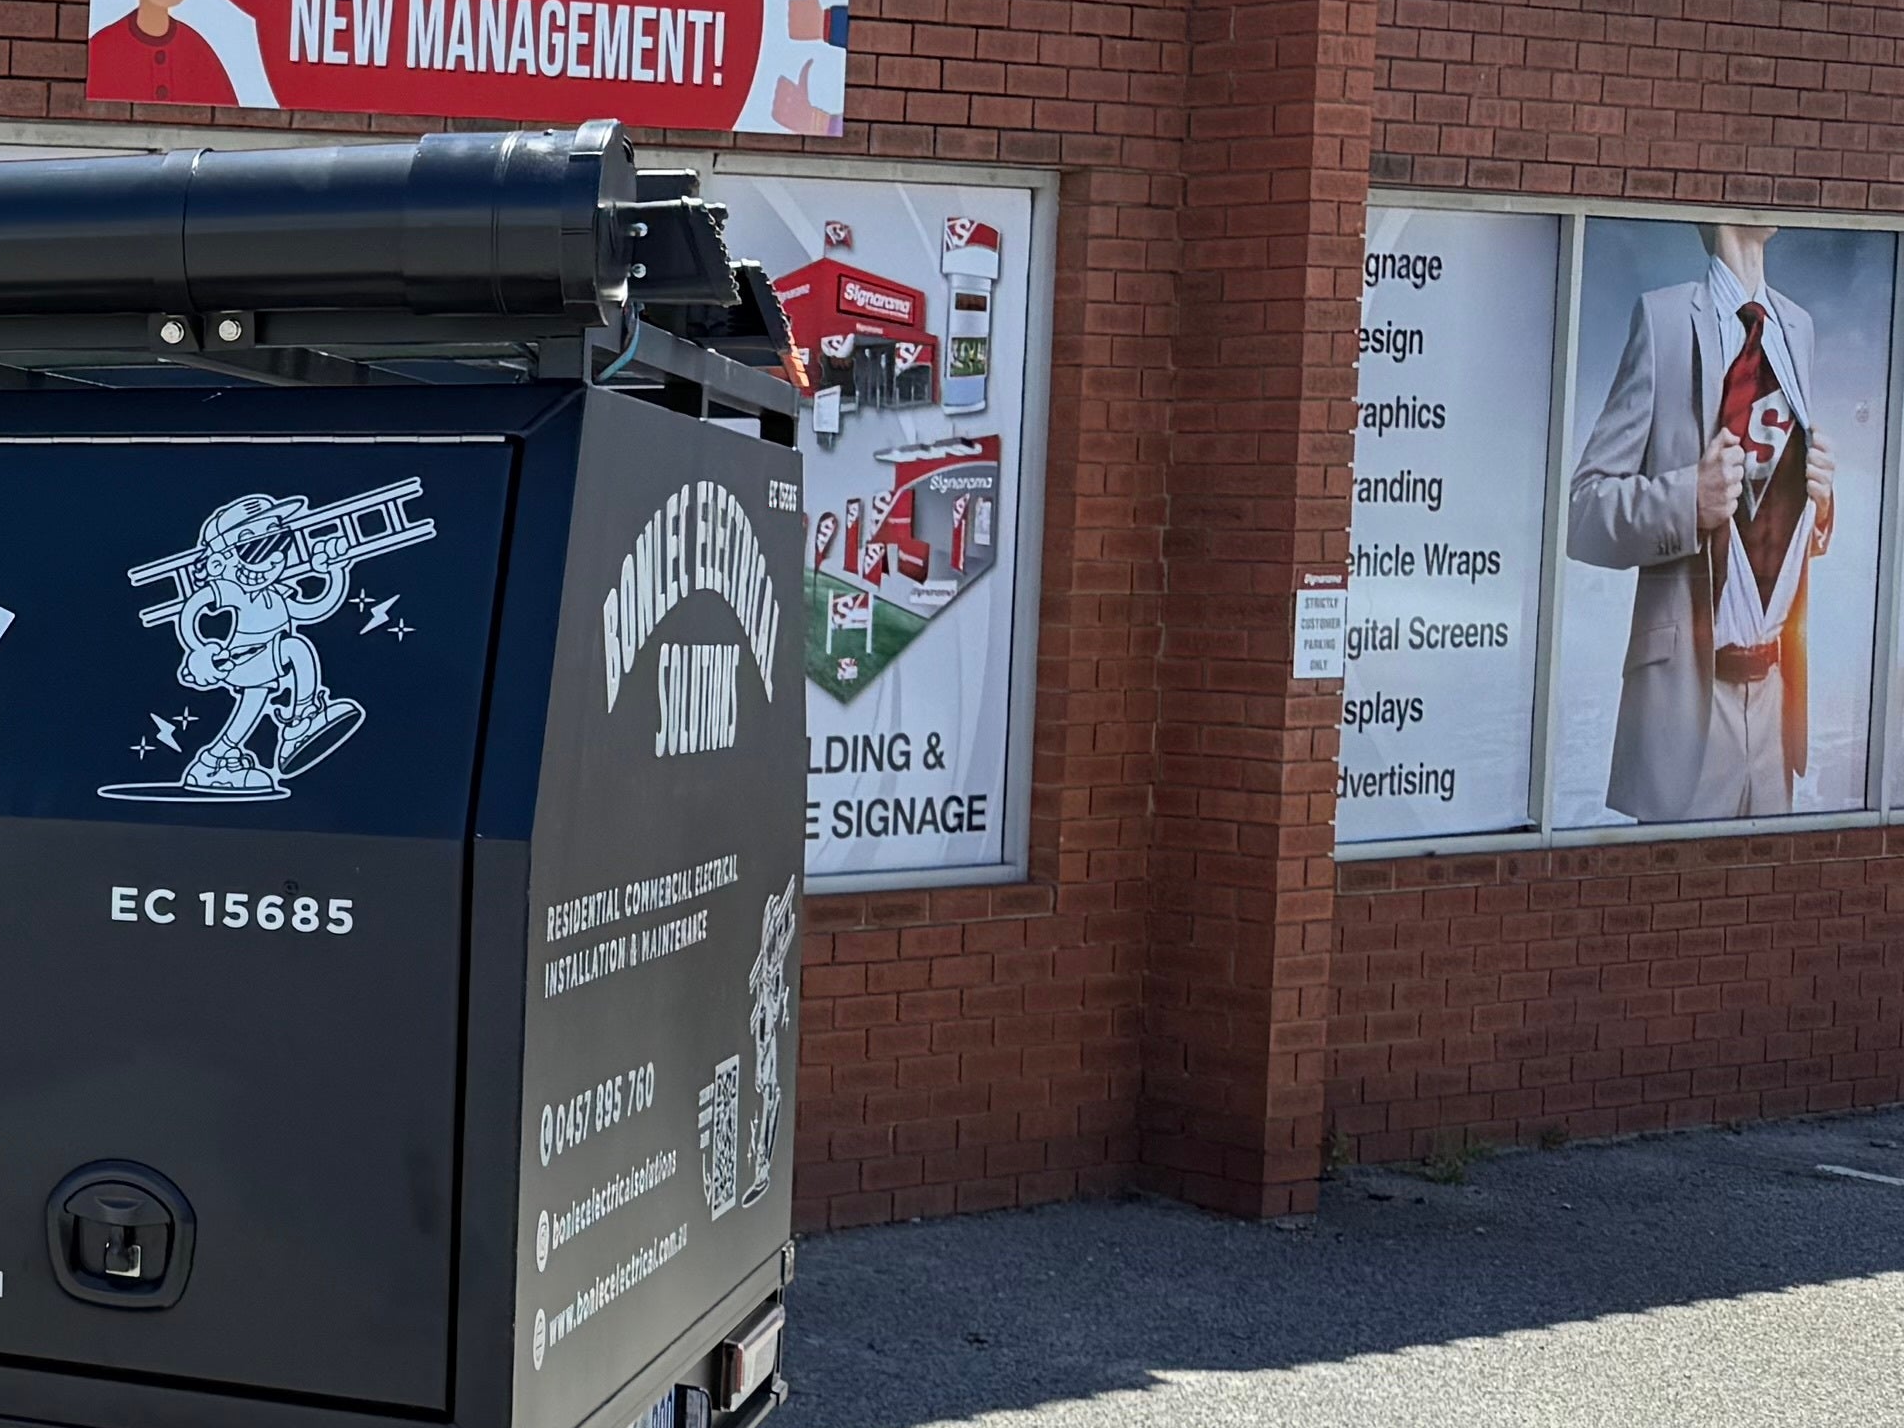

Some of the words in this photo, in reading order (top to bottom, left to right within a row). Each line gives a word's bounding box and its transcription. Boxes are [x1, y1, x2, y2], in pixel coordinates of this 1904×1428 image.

[844, 283, 910, 313] Signarama
[1357, 394, 1446, 438] aphics
[929, 475, 992, 493] Signarama
[1354, 469, 1443, 512] anding
[1425, 544, 1502, 585] Wraps
[603, 484, 690, 713] BONLEC
[696, 481, 779, 703] ELECTRICAL
[1408, 616, 1509, 652] Screens
[1310, 660, 1328, 671] ONLY
[655, 643, 740, 758] SOLUTIONS
[923, 732, 945, 771] &
[832, 795, 987, 840] SIGNAGE
[111, 888, 176, 925] EC
[199, 891, 354, 934] 15685
[546, 887, 620, 942] RESIDENTIAL
[624, 869, 692, 917] COMMERCIAL
[695, 853, 738, 895] ELECTRICAL
[544, 937, 626, 999] INSTALLATION
[629, 932, 638, 967] &
[642, 910, 707, 963] MAINTENANCE
[555, 1090, 591, 1155] 0457
[595, 1075, 622, 1134] 895
[627, 1062, 655, 1117] 760
[552, 1150, 677, 1253] bonlecelectricalsolutions
[548, 1224, 688, 1348] www.bonlecelectrical.com.au
